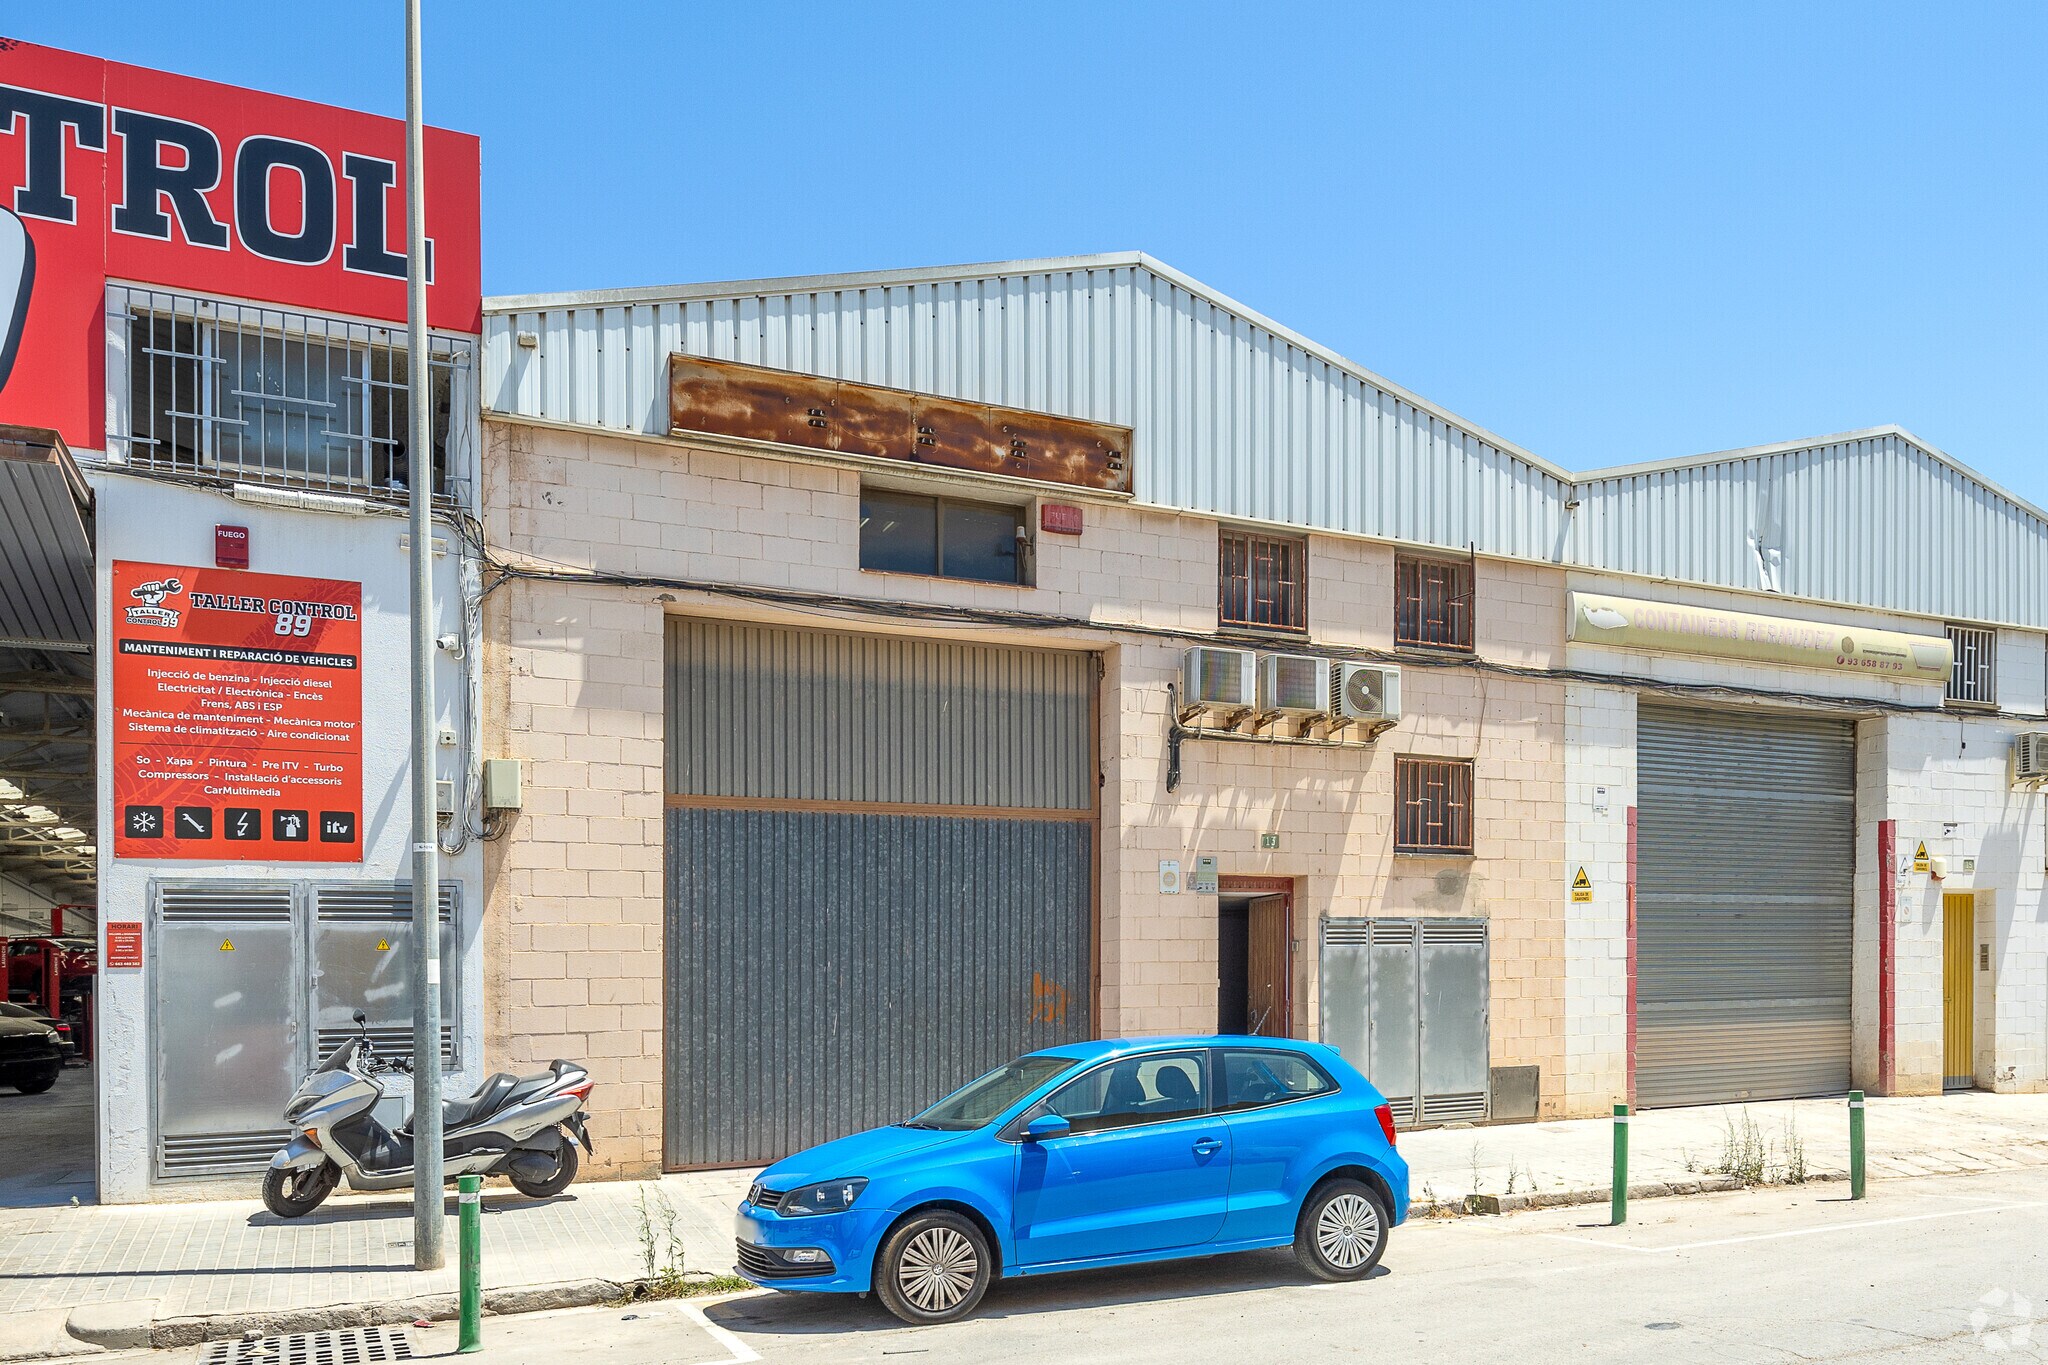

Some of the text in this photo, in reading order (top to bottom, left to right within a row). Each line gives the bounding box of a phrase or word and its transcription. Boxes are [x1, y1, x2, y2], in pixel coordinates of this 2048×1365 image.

[217, 530, 246, 539] FUEGO
[133, 609, 171, 618] TALLER
[189, 592, 357, 621] TALLER CONTROL
[126, 616, 179, 628] CONTROL 89
[274, 613, 312, 637] 89
[1634, 608, 1738, 639] CONTAINERS
[125, 643, 211, 657] MANTENIMENT
[220, 650, 282, 662] REPARACIÓ
[285, 655, 299, 663] DE
[301, 656, 353, 667] VEHICLES
[1847, 658, 1902, 670] 93 658 87 93
[147, 669, 190, 679] Injecció
[193, 672, 206, 680] de
[209, 673, 250, 683] benzina
[260, 676, 300, 686] Injecció
[303, 679, 332, 688] diesel
[158, 683, 215, 694] Electricitat
[225, 687, 283, 698] Electrònica
[294, 691, 323, 700] Encès
[201, 699, 282, 711] Frens, ABS i ESP
[123, 708, 174, 719] Mecànica
[177, 711, 190, 720] de
[193, 713, 263, 724] manteniment
[274, 716, 321, 726] Mecànica
[324, 720, 355, 729] motor
[129, 722, 171, 733] Sistema
[174, 725, 187, 733] de
[190, 726, 257, 737] climatització
[267, 730, 288, 738] Aire
[290, 732, 350, 741] condicionat
[136, 756, 150, 764] So
[166, 757, 193, 766] Xapa
[209, 758, 247, 768] Pintura
[262, 761, 279, 769] Pre
[282, 762, 299, 770] ITV
[314, 763, 344, 772] Turbo
[138, 770, 209, 780] Compressors
[204, 786, 281, 796] CarMultimèdia
[326, 821, 348, 833] itv
[1266, 836, 1276, 846] 13
